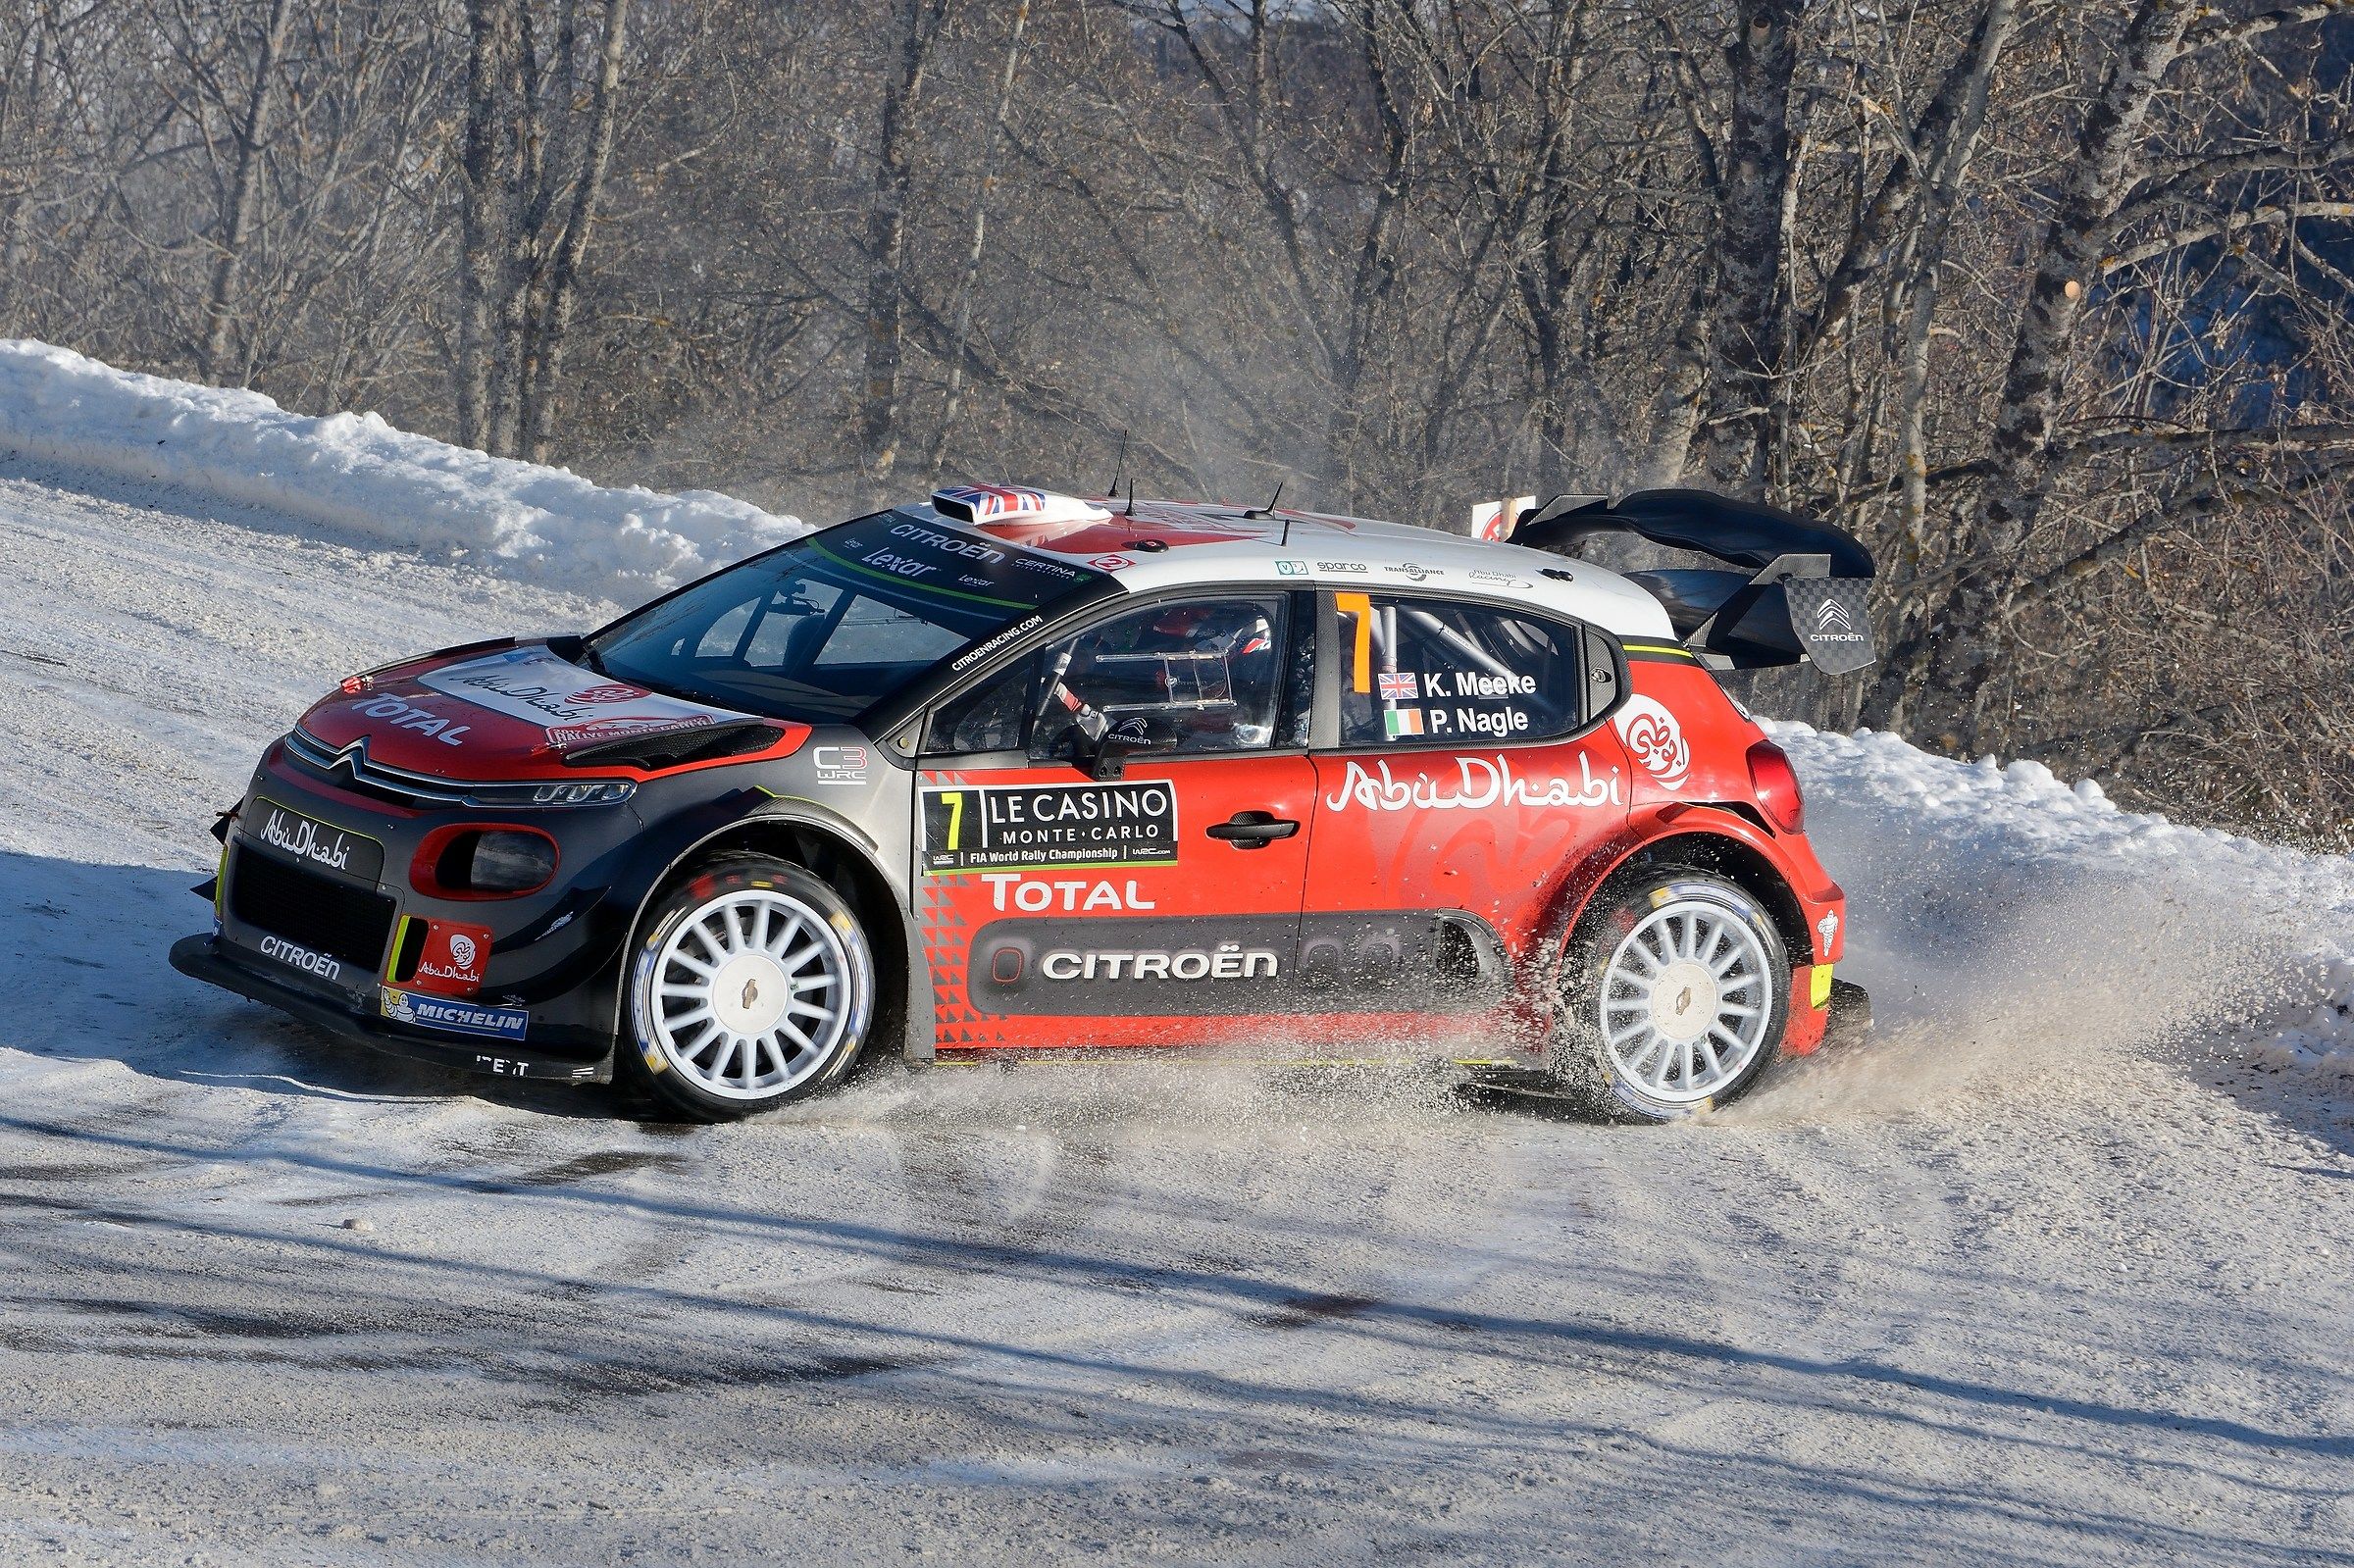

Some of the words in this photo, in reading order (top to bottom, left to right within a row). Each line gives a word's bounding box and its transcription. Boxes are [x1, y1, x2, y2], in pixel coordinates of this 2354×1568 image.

[890, 523, 1006, 565] CITROËN
[861, 546, 938, 577] Lexar
[1015, 558, 1076, 578] CERTINA
[1316, 561, 1367, 573] sparco
[1383, 566, 1445, 576] TRANSALLIANCE
[958, 574, 995, 587] Lexar
[951, 615, 1043, 672] CITROENRACING.COM
[1334, 592, 1371, 693] 7
[1810, 632, 1865, 642] CITROËN
[1424, 673, 1451, 698] K.
[1457, 671, 1537, 696] Meeke
[351, 692, 471, 746] TOTAL
[1430, 709, 1453, 733] P.
[1458, 706, 1529, 737] Nagle
[1107, 733, 1151, 745] CITROËN
[813, 746, 868, 769] C3
[817, 770, 867, 780] WRC
[990, 795, 1025, 824] LE
[1032, 788, 1168, 822] CASINO
[941, 791, 963, 851] 7
[970, 852, 987, 864] FIA
[989, 850, 1019, 862] World
[1021, 849, 1047, 862] Rally
[1049, 847, 1118, 861] Championship
[981, 873, 1156, 912] TOTAL
[260, 935, 340, 981] CITROËN
[1043, 943, 1278, 980] CITROËN
[417, 1003, 524, 1030] MICHELIN
